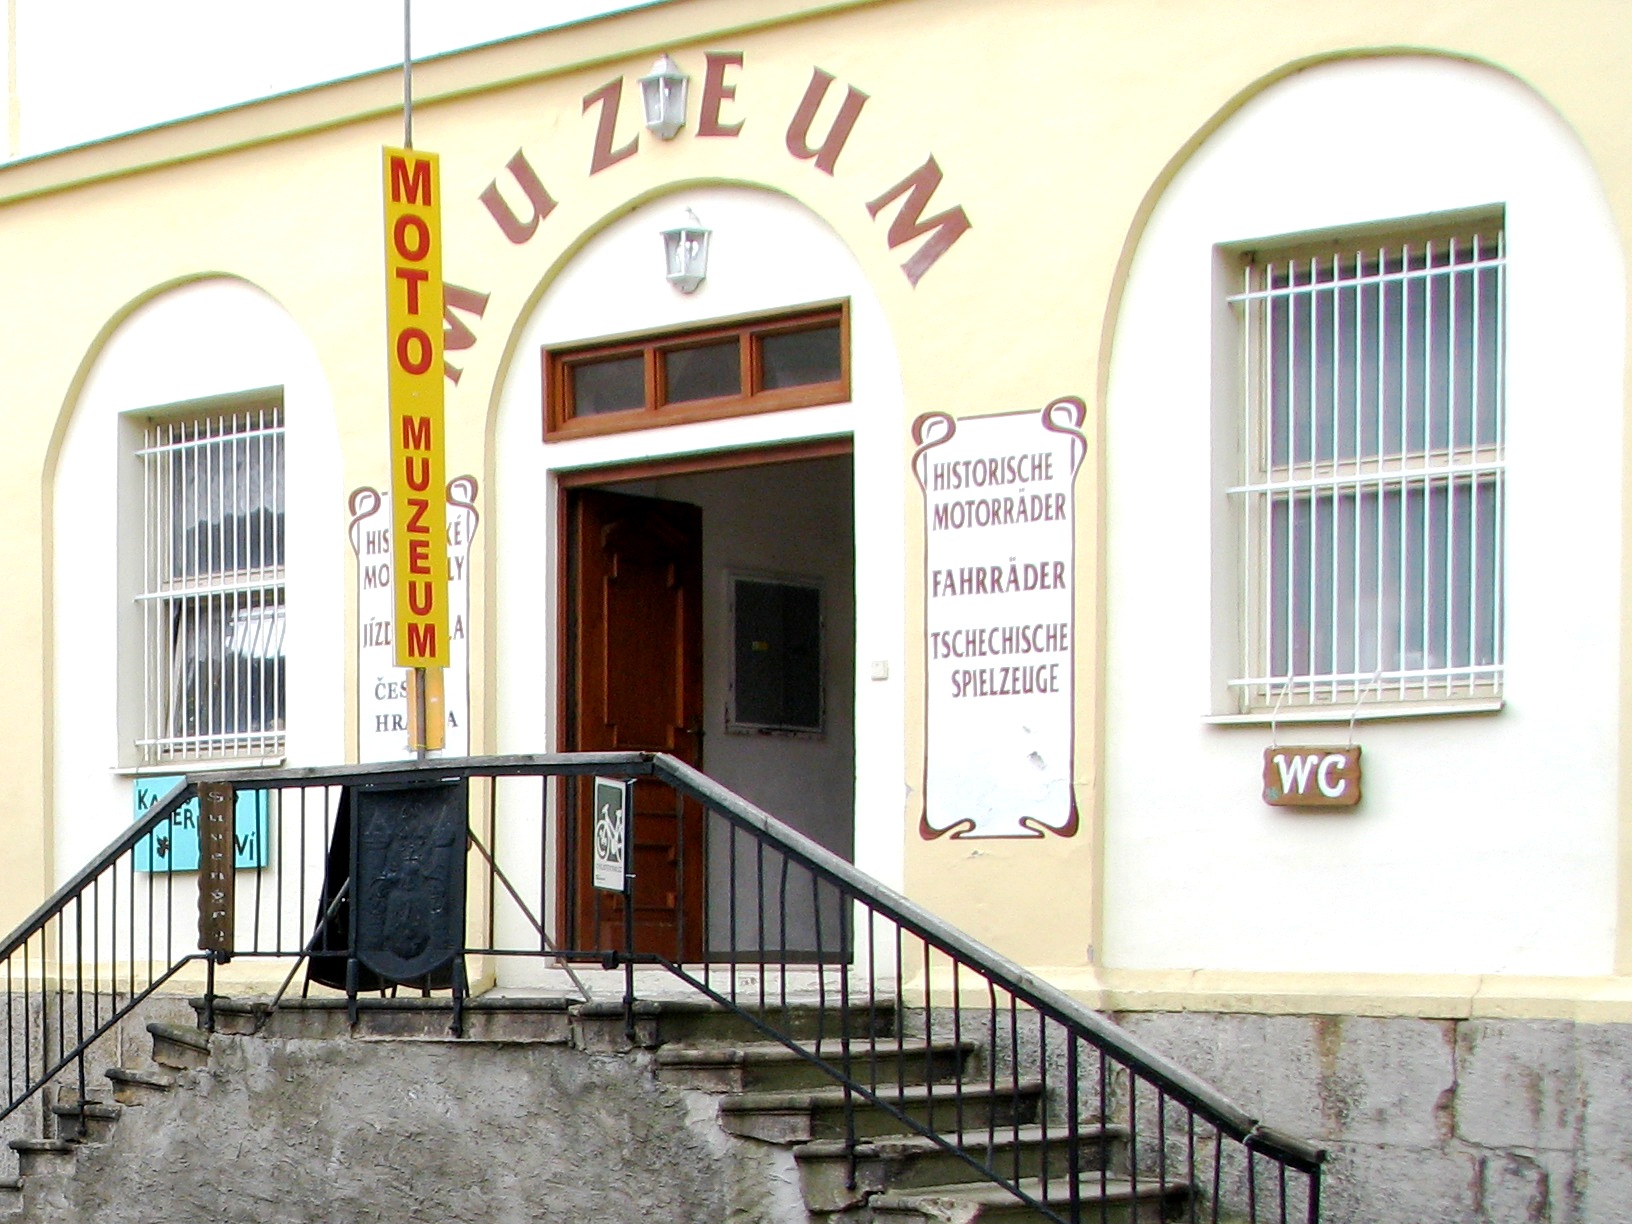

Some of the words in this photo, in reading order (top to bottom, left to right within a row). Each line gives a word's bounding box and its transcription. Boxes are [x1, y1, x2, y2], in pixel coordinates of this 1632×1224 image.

[442, 51, 973, 386] MUZEUM
[390, 156, 433, 376] MOTO
[932, 452, 1054, 491] HISTORISCHE
[932, 488, 1067, 531] MOTORRÄDER
[403, 415, 437, 659] MUZEUM
[932, 556, 1067, 598] FAHRRÄDER
[930, 622, 1069, 660] TSCHECHISCHE
[951, 663, 1060, 698] SPIELZEUGE
[1273, 754, 1346, 798] WC
